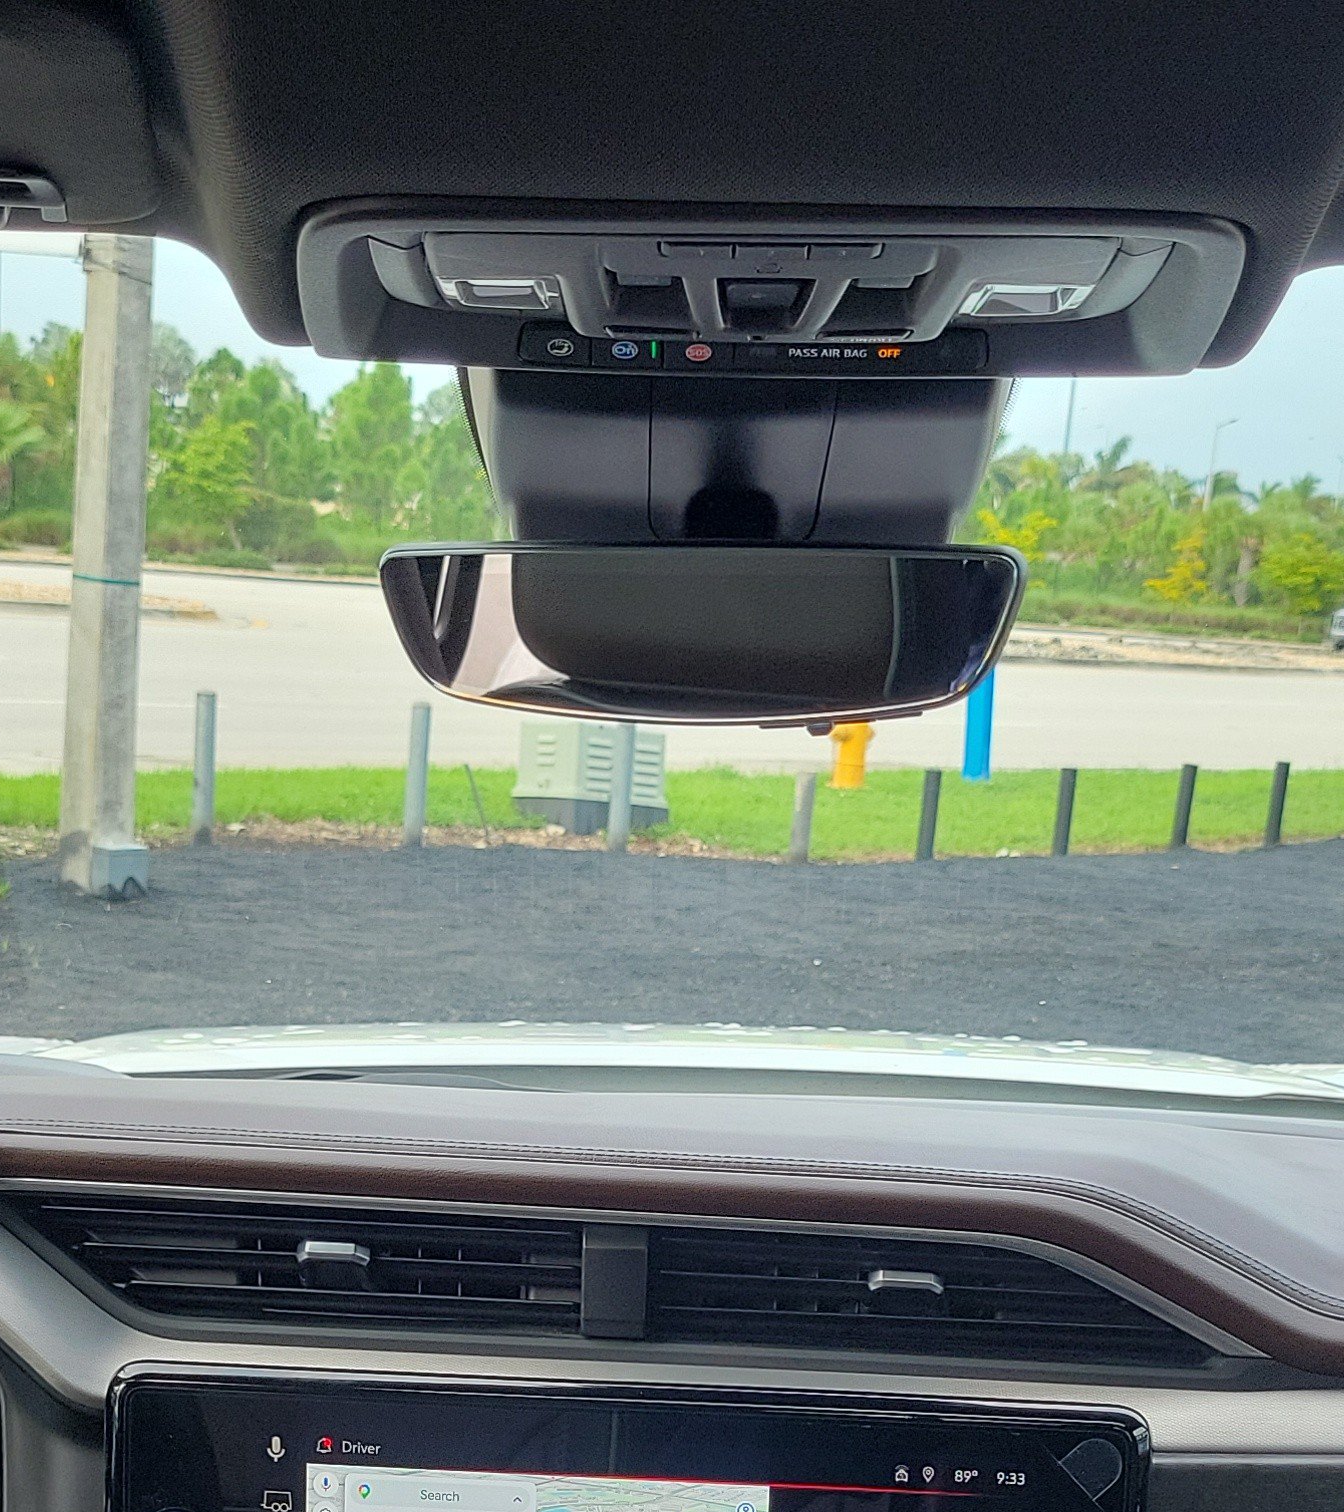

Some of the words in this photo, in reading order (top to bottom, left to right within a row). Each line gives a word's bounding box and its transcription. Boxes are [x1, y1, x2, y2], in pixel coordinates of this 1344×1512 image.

[788, 348, 818, 358] PASS
[820, 348, 841, 358] AIR
[843, 348, 868, 359] BAG
[877, 348, 901, 359] OFF
[342, 1440, 381, 1455] Driver
[996, 1471, 1026, 1486] 9:33
[420, 1488, 460, 1502] Search
